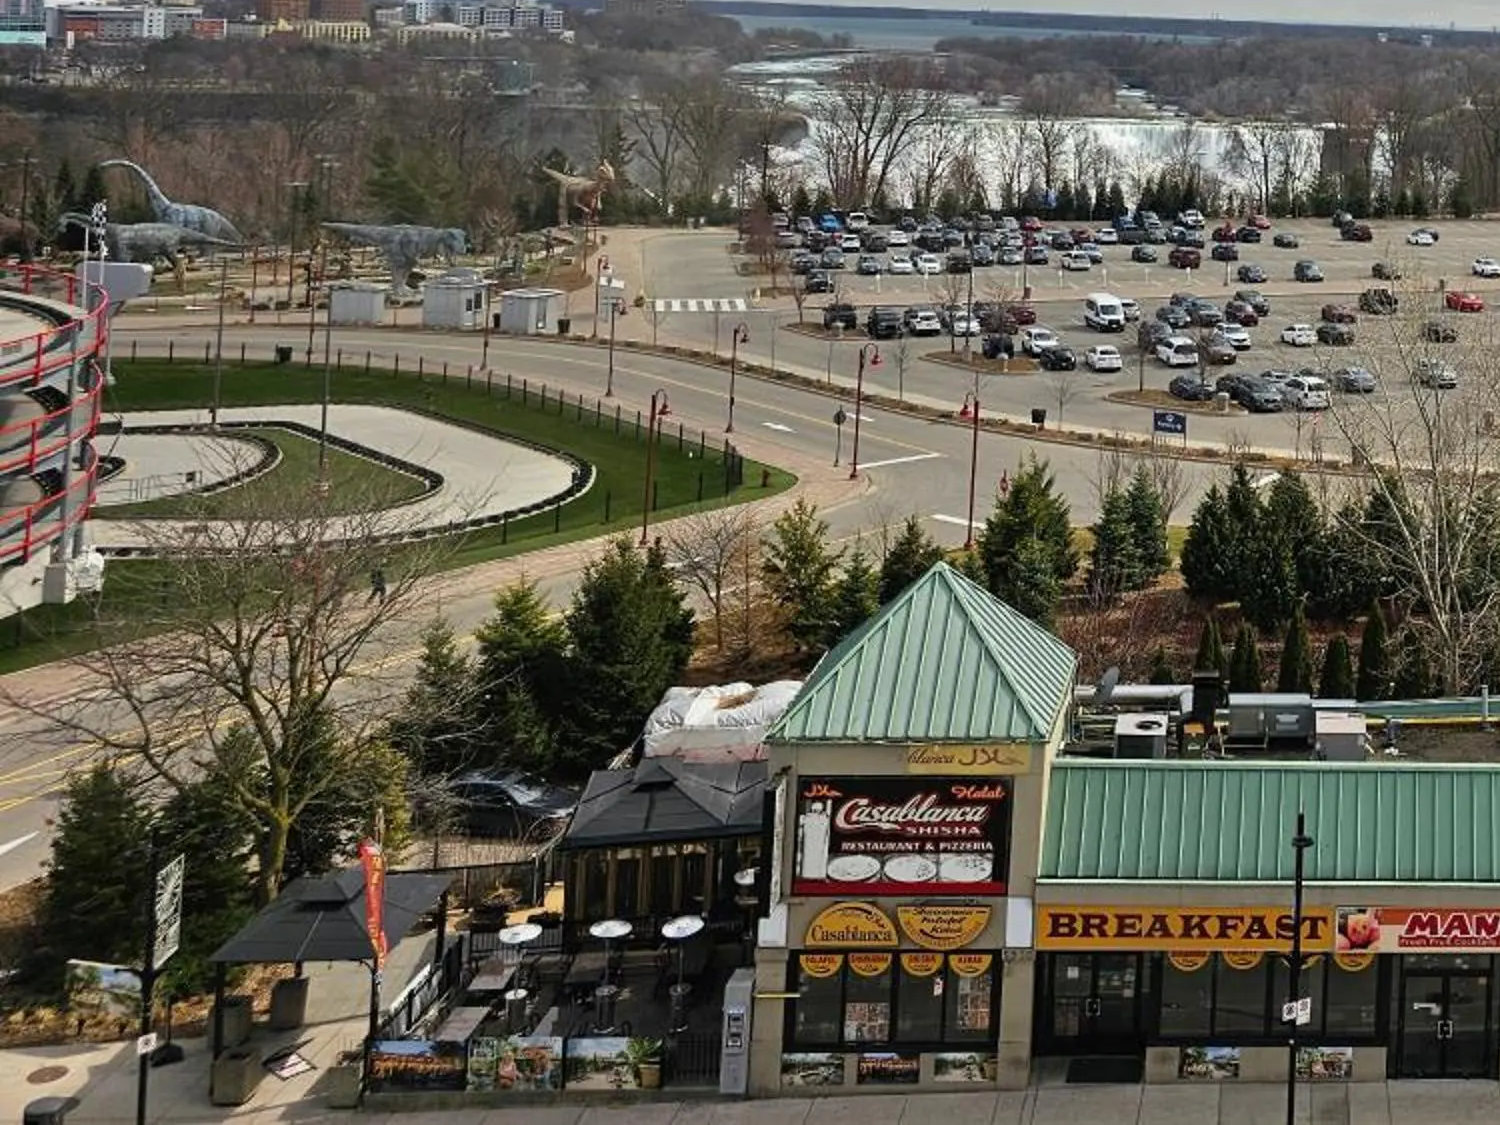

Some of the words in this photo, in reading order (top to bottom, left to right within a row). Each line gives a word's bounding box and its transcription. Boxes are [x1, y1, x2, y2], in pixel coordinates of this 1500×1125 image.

[951, 784, 1005, 798] Halal
[835, 794, 989, 831] Casablanca
[905, 826, 982, 836] SHISHA
[841, 842, 920, 851] RESTAURANT
[925, 842, 934, 851] &
[939, 842, 993, 851] PIZZERIA
[811, 924, 893, 942] Casablanca
[1047, 912, 1328, 940] BREAKFAST
